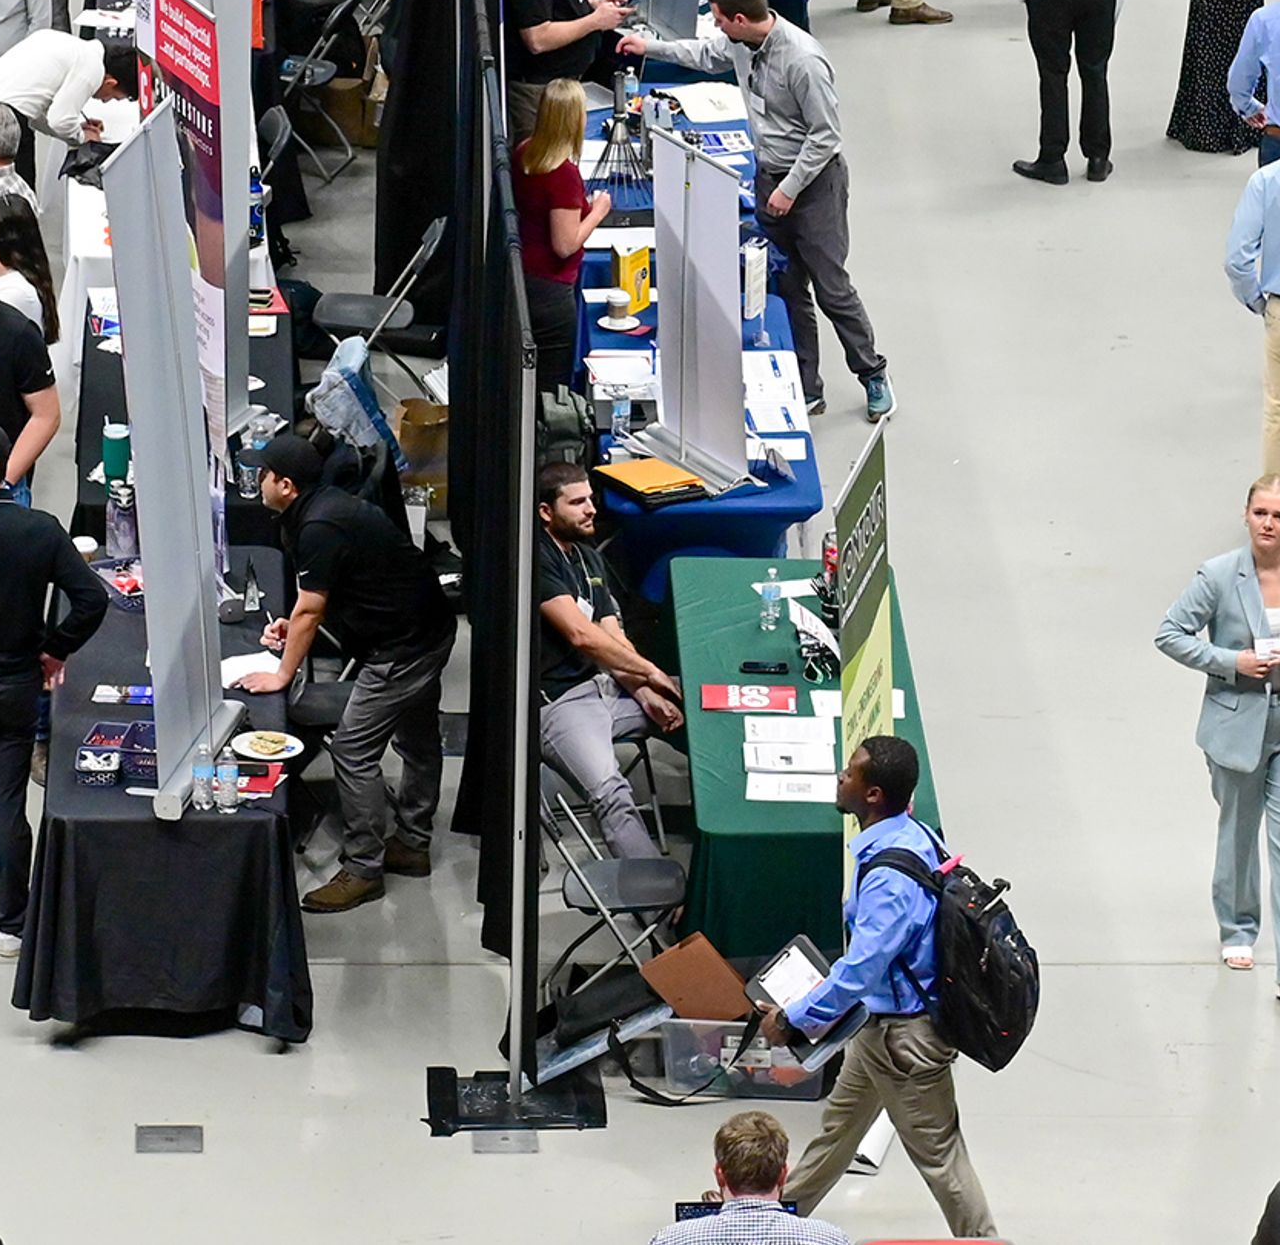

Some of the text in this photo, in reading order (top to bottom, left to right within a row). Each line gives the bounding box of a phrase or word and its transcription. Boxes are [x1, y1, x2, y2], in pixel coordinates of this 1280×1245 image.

[160, 19, 212, 69] community spaces
[168, 1, 184, 30] build
[183, 12, 212, 49] impactful
[174, 49, 212, 89] partnerships.
